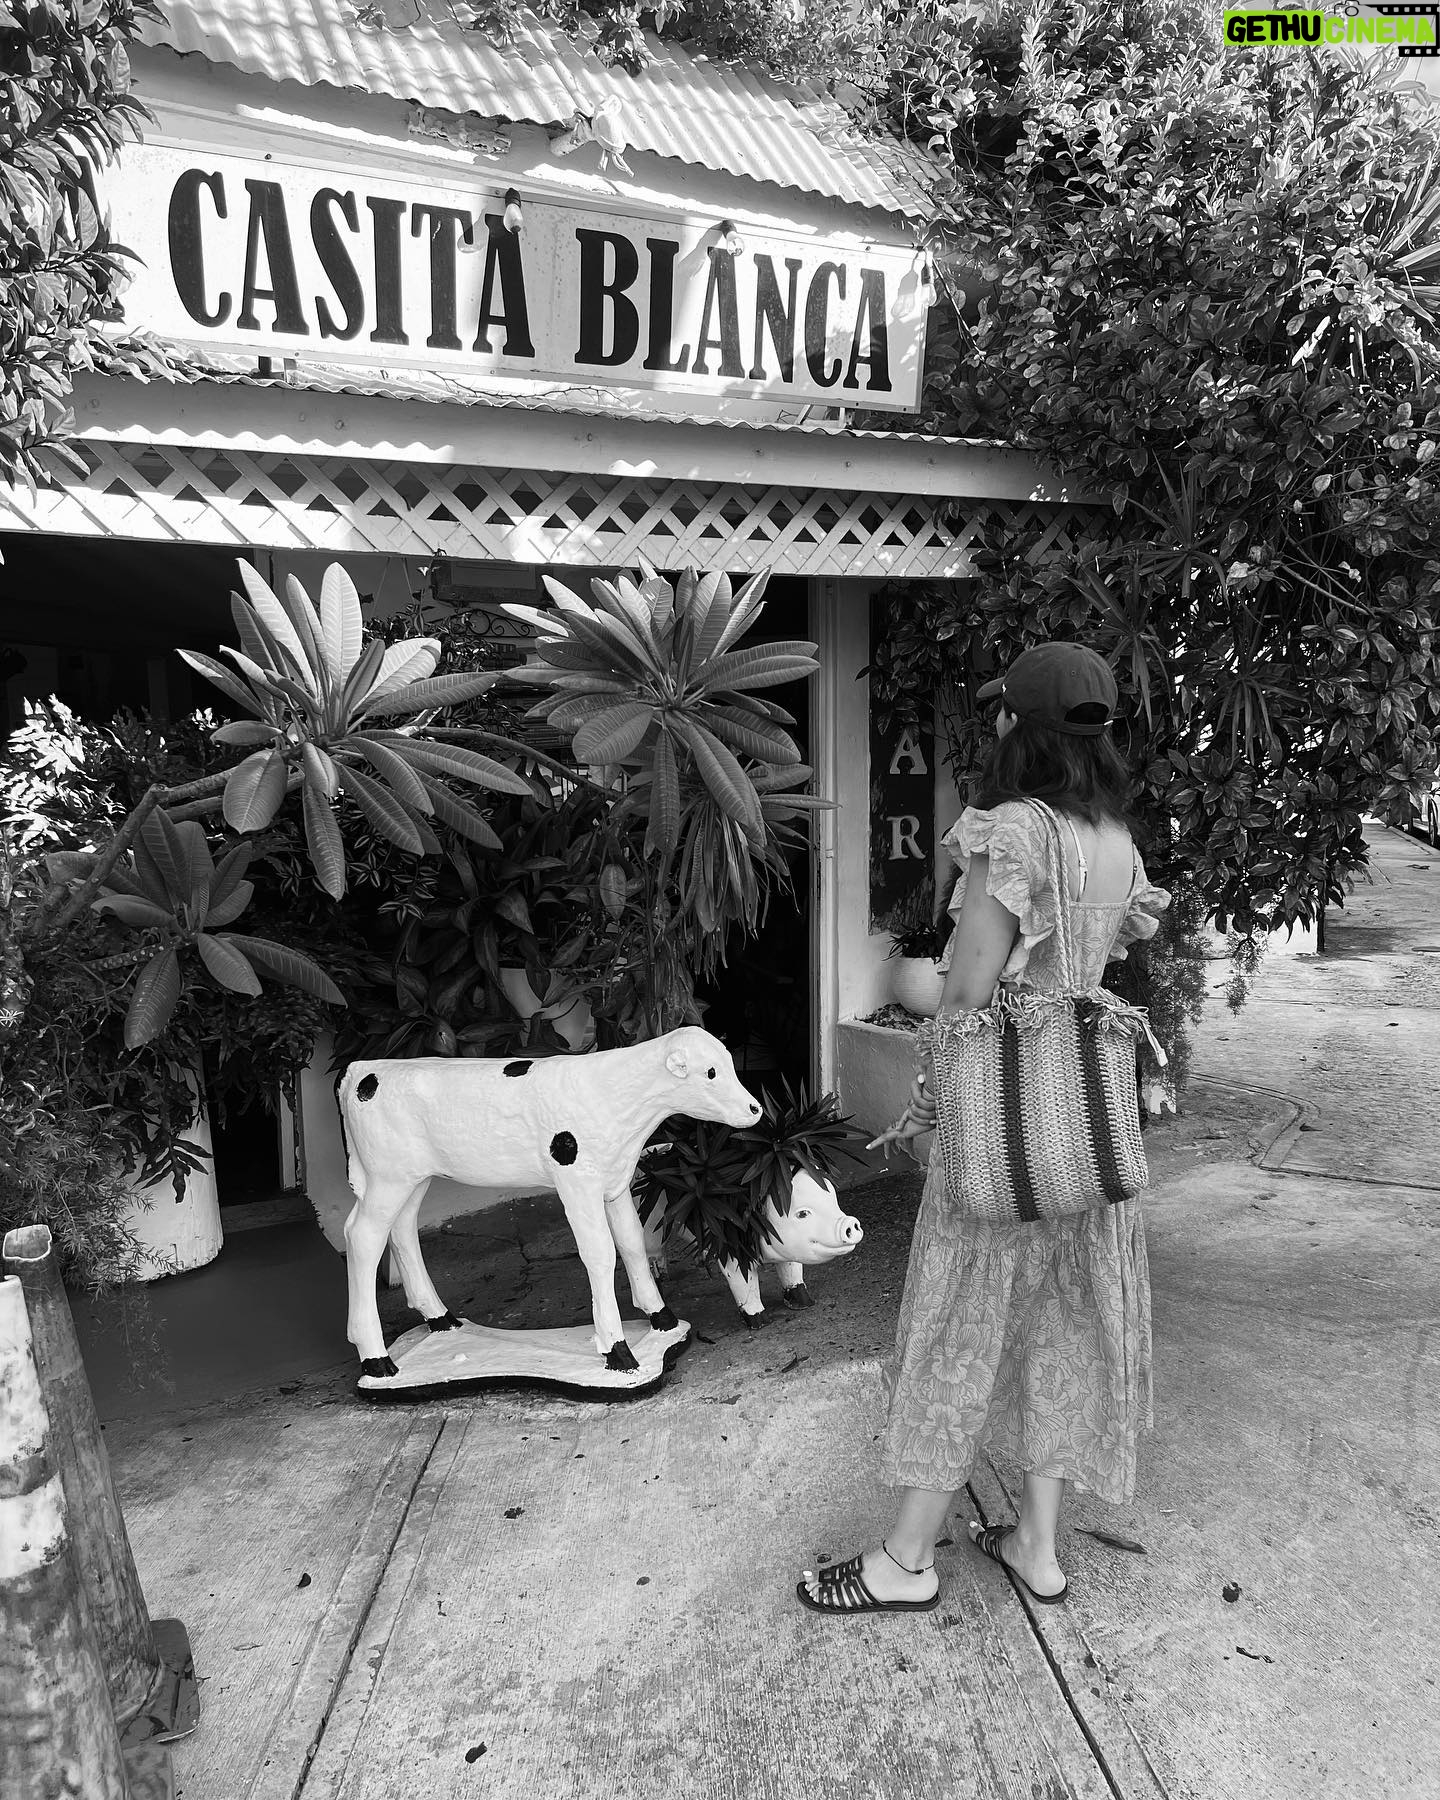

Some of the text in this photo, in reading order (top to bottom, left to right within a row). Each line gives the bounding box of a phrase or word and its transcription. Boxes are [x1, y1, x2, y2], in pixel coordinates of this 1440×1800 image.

[168, 168, 535, 358] CASITA
[575, 228, 893, 392] BLANCA
[886, 728, 929, 861] AR
